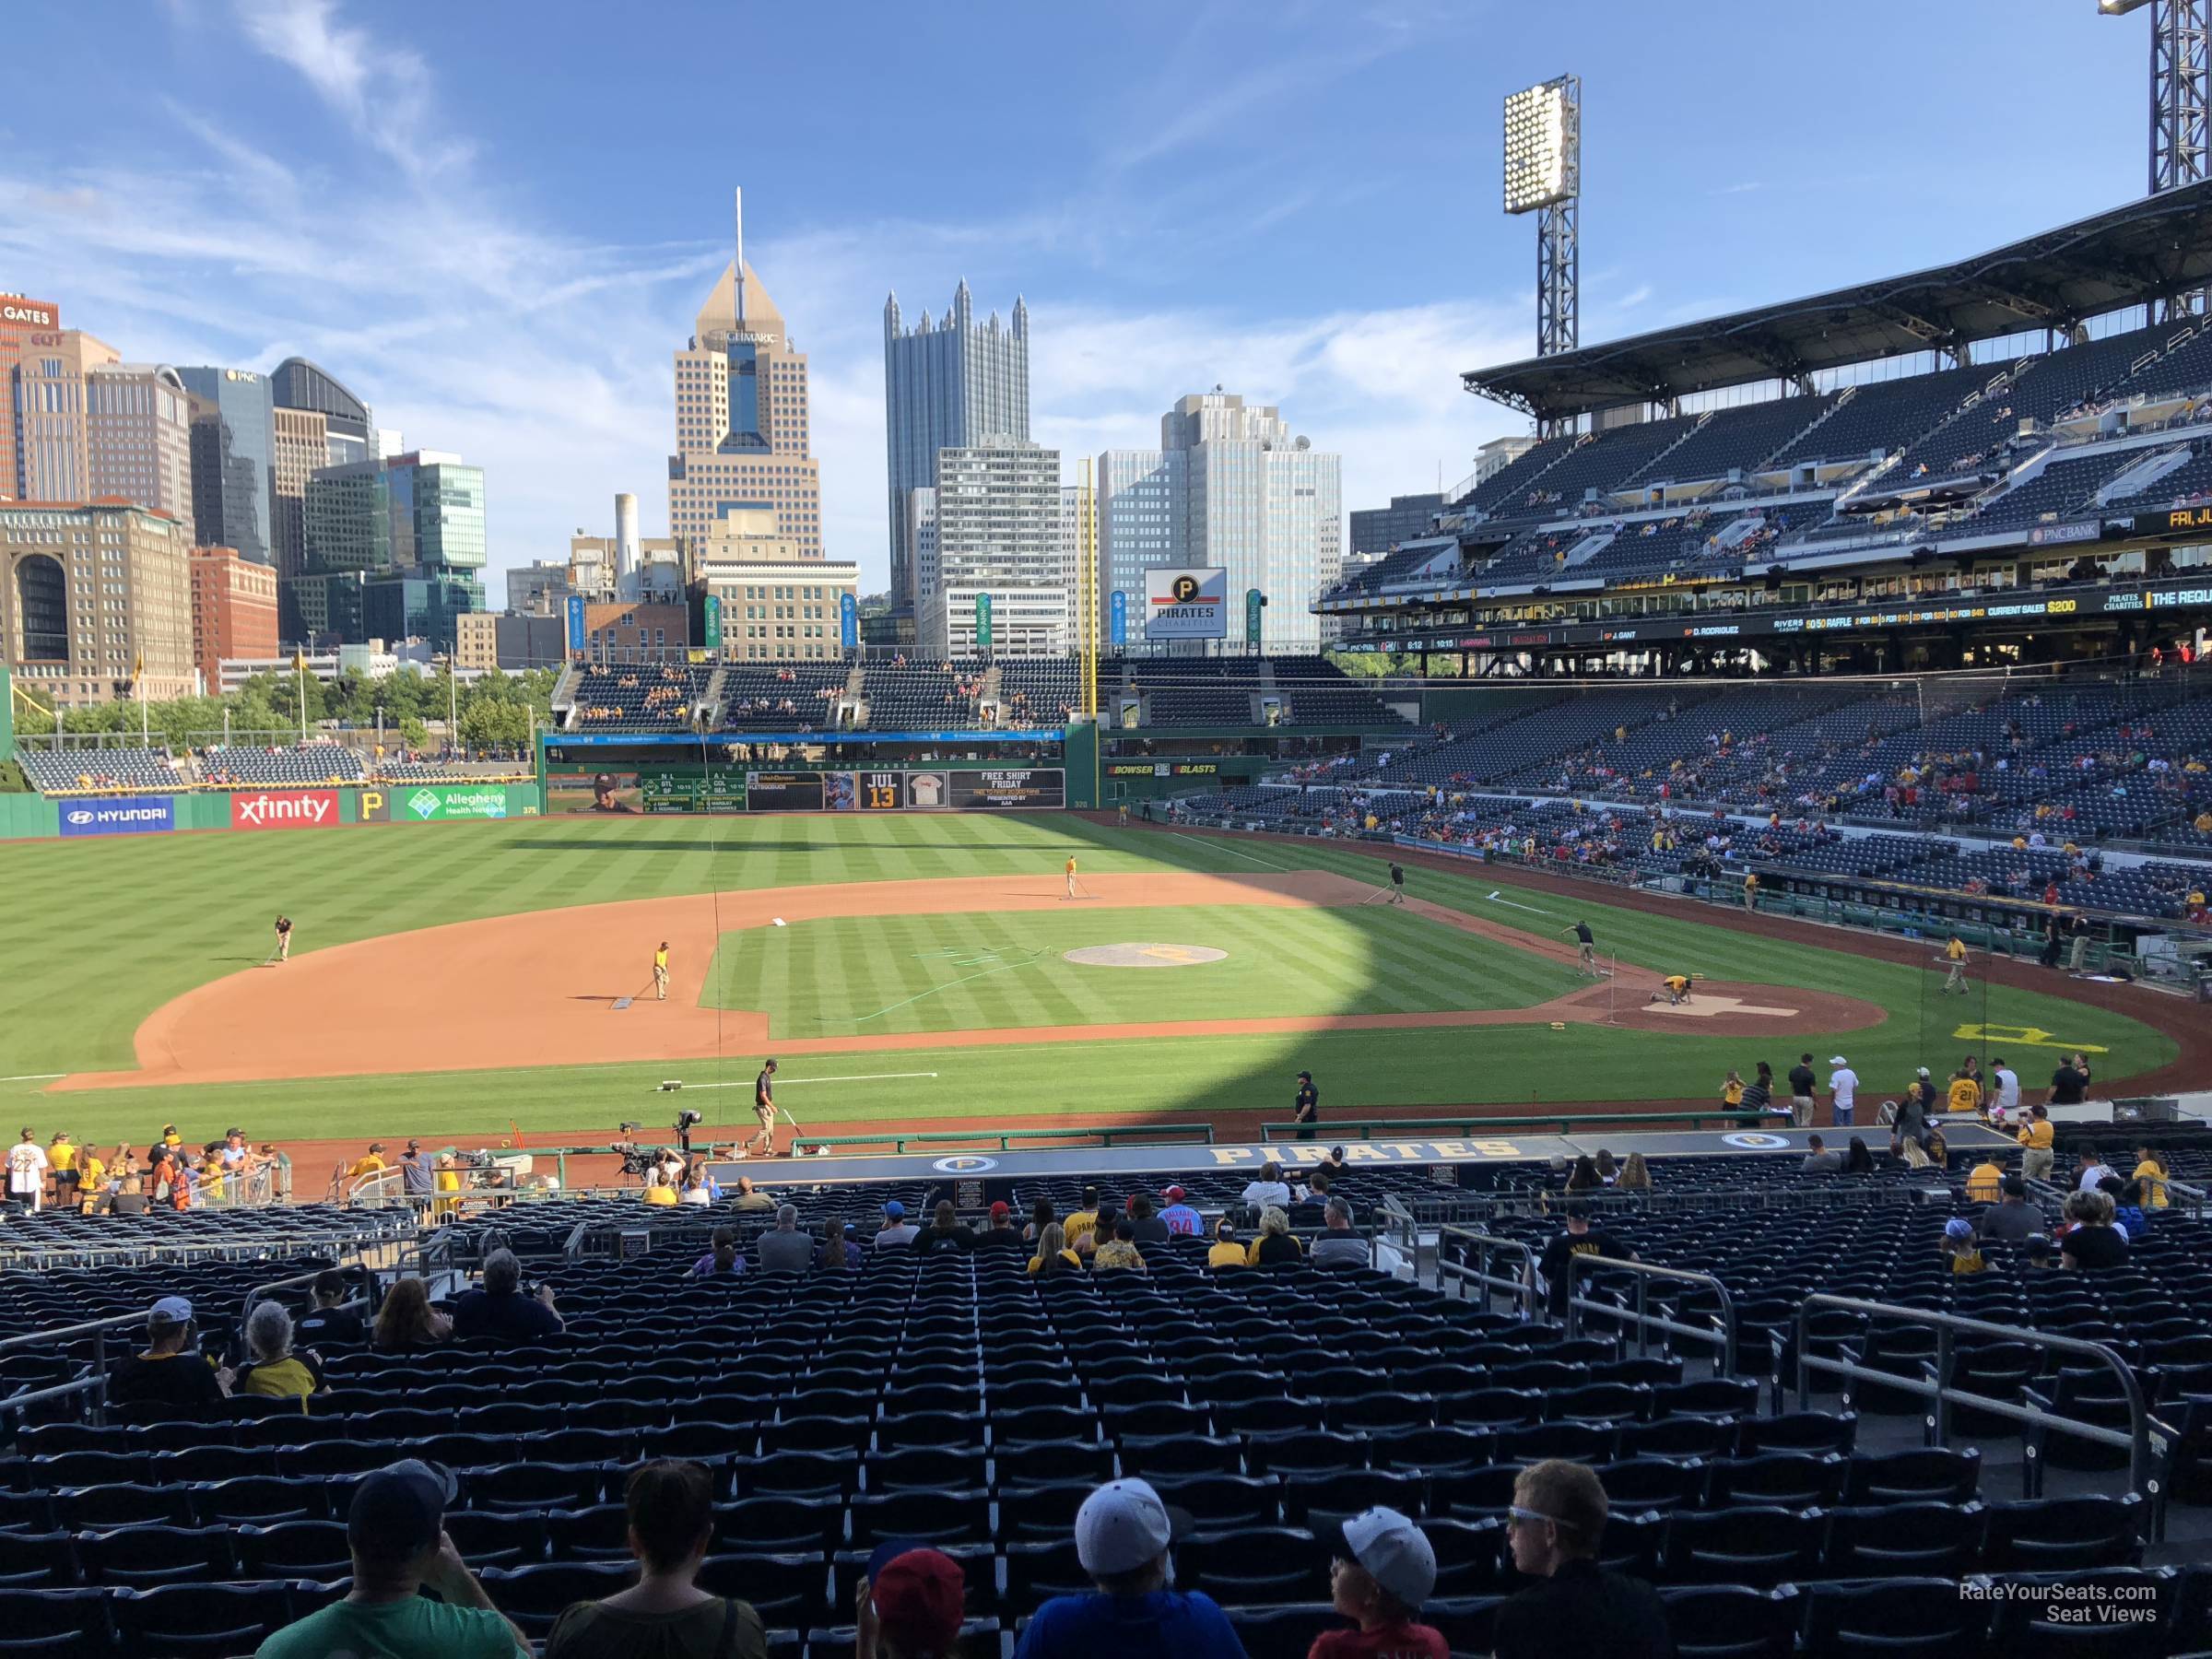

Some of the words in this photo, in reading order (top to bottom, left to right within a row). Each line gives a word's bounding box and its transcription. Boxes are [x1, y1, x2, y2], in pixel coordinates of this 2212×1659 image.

[4, 306, 50, 325] GATES
[30, 333, 65, 347] EQT
[237, 371, 258, 383] PNC
[2170, 511, 2195, 527] FRI,
[2044, 527, 2066, 540] PNC
[2067, 524, 2095, 537] BANK
[1180, 581, 1193, 598] P
[2109, 593, 2139, 603] PIRATES
[2152, 592, 2176, 606] THE
[1988, 605, 2021, 617] CURRENT
[2022, 604, 2045, 614] SALES
[2048, 599, 2076, 613] $200
[2103, 600, 2144, 611] CHARITIES
[1158, 607, 1215, 618] PIRATES
[1921, 612, 1933, 620] FOR
[1958, 609, 1971, 618] FOR
[1158, 619, 1215, 628] CHARITIES
[1774, 618, 1804, 628] RIVERS
[1827, 617, 1853, 628] RAFFLE
[1860, 616, 1871, 624] FOR
[1886, 615, 1897, 623] FOR
[1701, 626, 1739, 635] RODRIGUEZ
[1436, 639, 1453, 648] 10:15
[874, 762, 909, 771] PARK
[1114, 765, 1154, 774] BOWSER
[1180, 765, 1216, 773] BLASTS
[867, 773, 898, 788] JUL
[981, 771, 1004, 781] FREE
[1006, 771, 1031, 781] SHIRT
[992, 780, 1022, 789] FRIDAY
[445, 793, 505, 806] Allegheny
[870, 787, 894, 808] 13
[239, 794, 331, 825] xfinity
[361, 791, 383, 820] P
[445, 806, 471, 816] Health
[472, 805, 505, 815] Network
[98, 806, 167, 823] HYUNDAI
[1209, 1139, 1522, 1165] PIRATES
